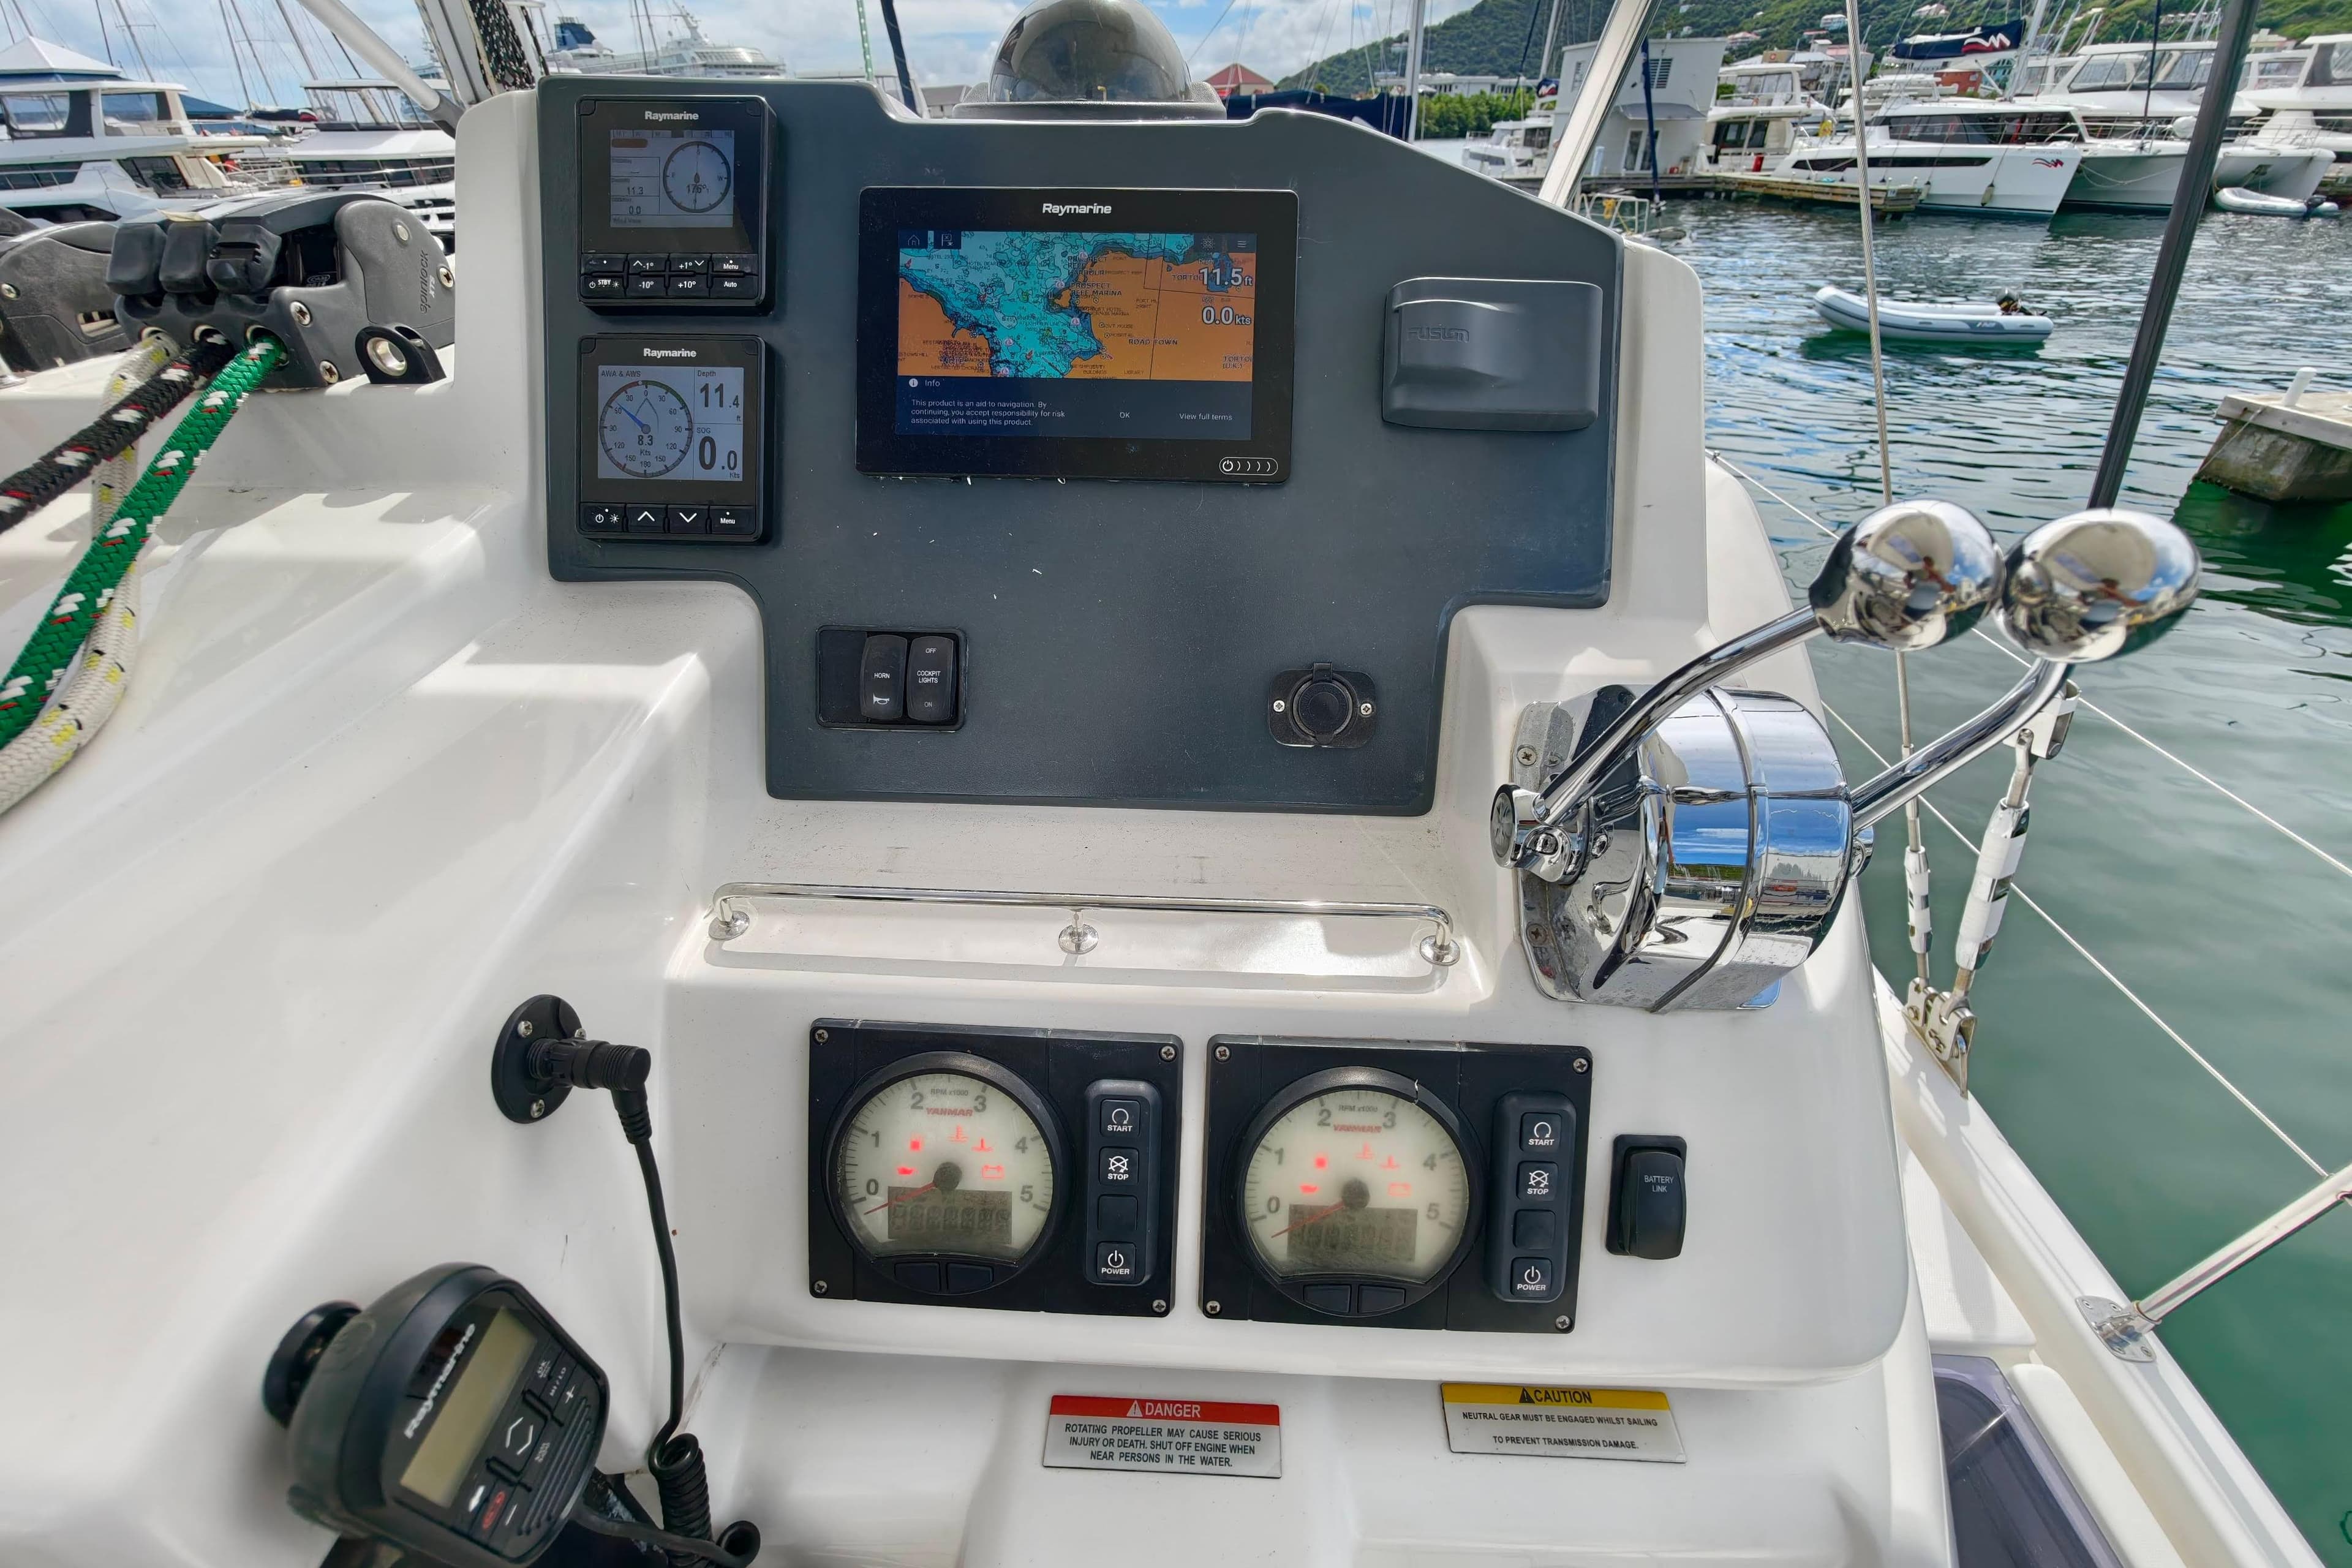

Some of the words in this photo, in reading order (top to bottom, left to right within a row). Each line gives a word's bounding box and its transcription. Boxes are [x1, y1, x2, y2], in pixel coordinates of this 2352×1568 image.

[644, 111, 699, 121] Raymarine
[1042, 203, 1112, 216] Raymarine
[420, 250, 431, 315] spinlock
[1199, 268, 1242, 286] 11.5
[1245, 276, 1253, 286] ft
[1202, 306, 1234, 325] 0.0
[1235, 315, 1251, 325] kts
[643, 348, 697, 358] Raymarine
[700, 382, 740, 409] 11.4
[638, 435, 654, 446] 8.3
[698, 436, 737, 470] 0.0
[911, 1091, 924, 1110] 2
[974, 1095, 987, 1113] 3
[925, 1107, 973, 1117] YANMAR
[1317, 1109, 1331, 1127] 2
[1382, 1111, 1396, 1129] 3
[872, 1133, 880, 1148] 1
[1015, 1137, 1028, 1153] 4
[1275, 1147, 1284, 1165] 1
[1423, 1154, 1438, 1171] 4
[866, 1178, 879, 1196] 0
[1020, 1185, 1033, 1202] 5
[1267, 1196, 1280, 1214] 0
[1426, 1202, 1441, 1220] 5
[1534, 1389, 1593, 1404] CAUTION
[1145, 1402, 1201, 1418] DANGER
[1463, 1411, 1498, 1420] NEUTRAL
[1558, 1415, 1594, 1424] ENGAGED
[1596, 1417, 1626, 1425] WHILST
[1627, 1418, 1657, 1427] SAILING
[1065, 1423, 1107, 1434] ROTATING
[1112, 1426, 1163, 1437] PROPELLER
[1167, 1428, 1185, 1438] MAY
[1189, 1429, 1219, 1439] CAUSE
[1223, 1431, 1261, 1442] SERIOUS
[1069, 1436, 1100, 1447] INJURY
[1102, 1438, 1115, 1447] OR
[1117, 1439, 1148, 1449] DEATH.
[1150, 1441, 1173, 1450] SHUT
[1175, 1441, 1192, 1452] OFF
[1194, 1442, 1227, 1453] ENGINE
[1229, 1444, 1255, 1455] WHEN
[1506, 1436, 1540, 1445] PREVENT
[1542, 1438, 1601, 1447] TRANSMISSION
[1602, 1439, 1639, 1449] DAMAGE.
[1090, 1450, 1114, 1461] NEAR
[1119, 1452, 1161, 1463] PERSONS
[1165, 1454, 1174, 1464] IN
[1178, 1455, 1196, 1465] THE
[1200, 1457, 1233, 1468] WATER.
